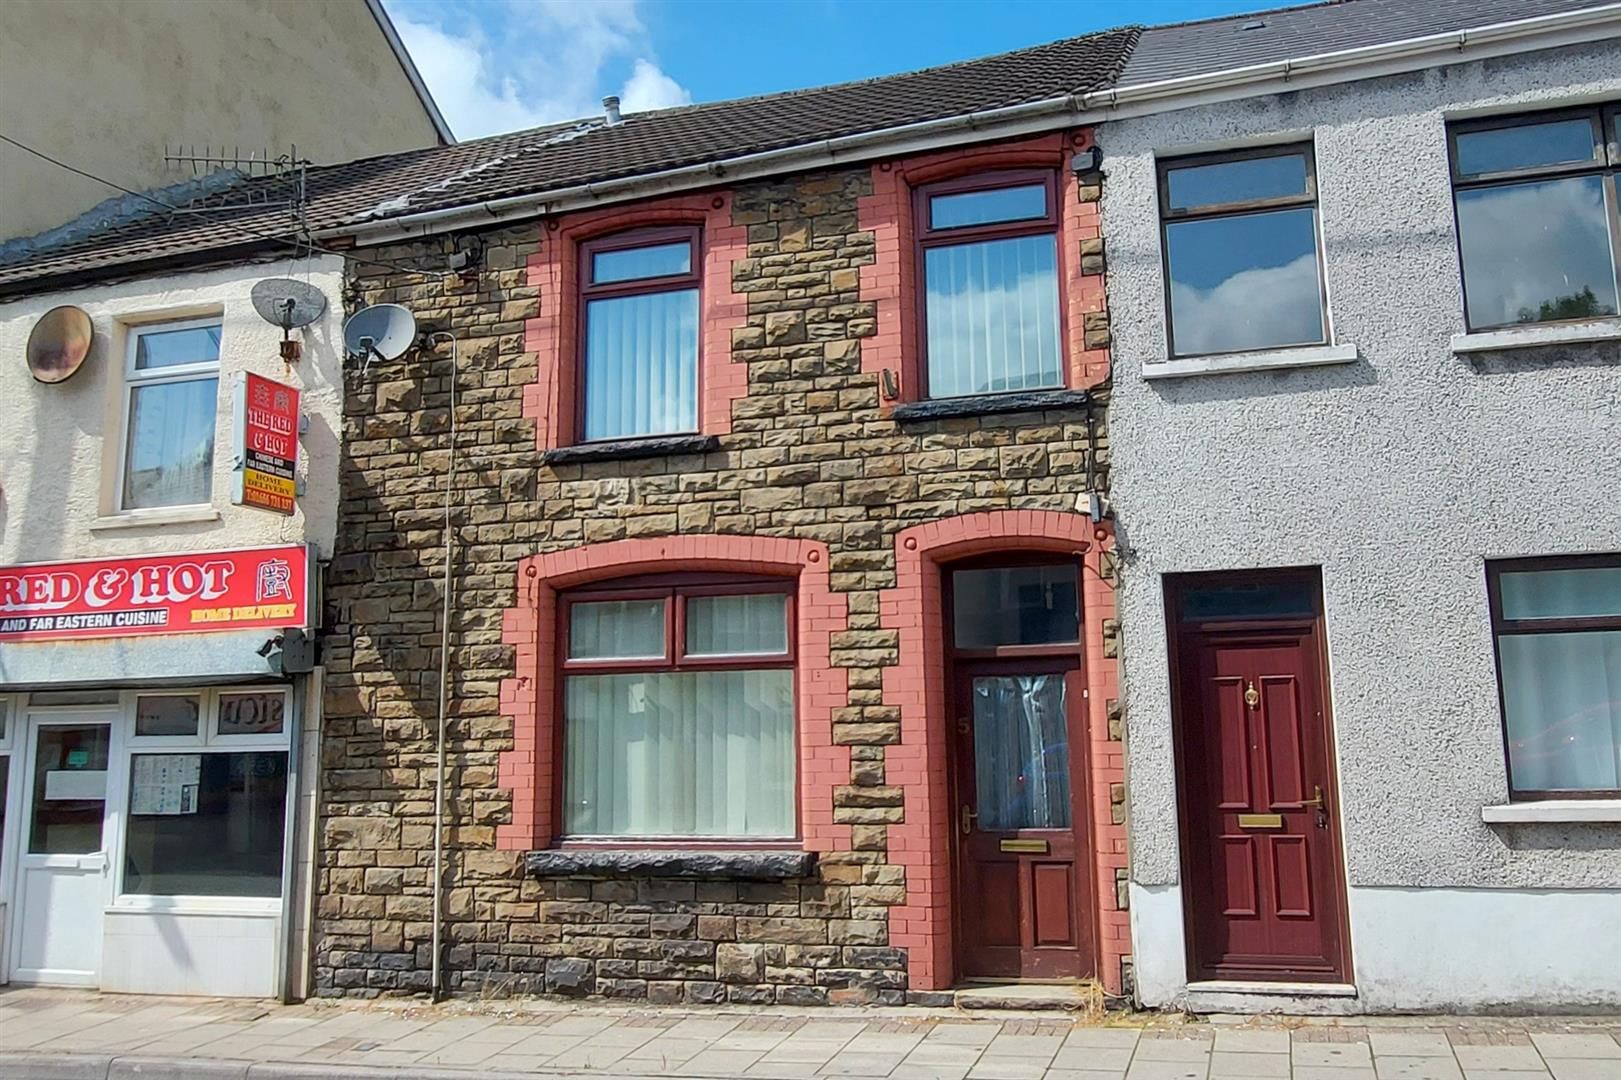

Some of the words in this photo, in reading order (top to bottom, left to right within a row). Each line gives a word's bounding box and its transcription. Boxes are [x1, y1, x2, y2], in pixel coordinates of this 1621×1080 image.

[248, 408, 270, 429] THE
[270, 413, 293, 436] RED
[264, 433, 288, 455] HOT
[248, 479, 291, 496] DELIVERY
[256, 472, 282, 486] HOME
[0, 573, 82, 609] RED
[85, 568, 128, 607] &
[131, 560, 235, 604] HOT
[1, 617, 27, 632] AND
[29, 615, 54, 631] FAR
[56, 612, 112, 629] EASTERN
[115, 610, 168, 626] CUISINE
[190, 608, 231, 623] HOME
[232, 604, 296, 621] DELIVERY
